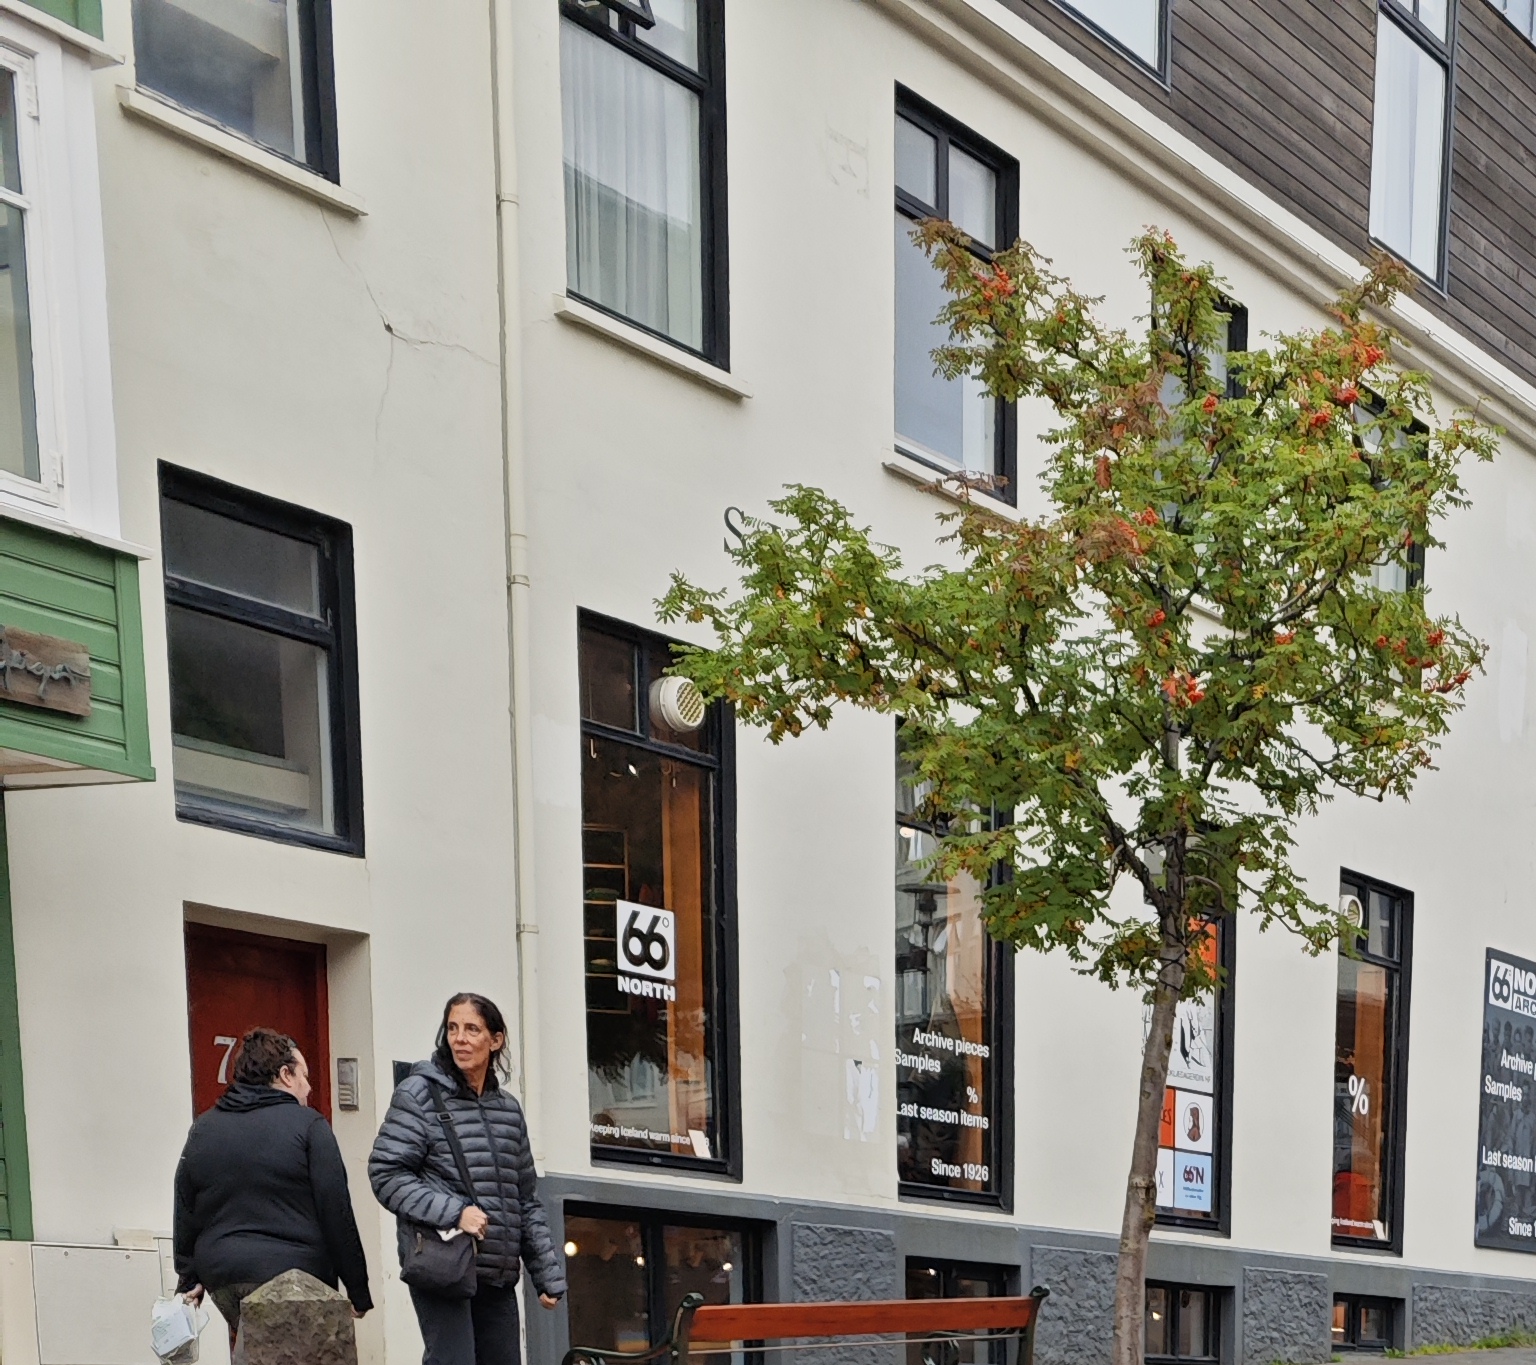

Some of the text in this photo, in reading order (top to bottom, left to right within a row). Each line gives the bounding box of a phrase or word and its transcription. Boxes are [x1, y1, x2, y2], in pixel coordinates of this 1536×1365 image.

[617, 975, 676, 1001] NORTH
[912, 1027, 990, 1058] Archive pieces
[895, 1048, 941, 1073] Samples
[1500, 1049, 1533, 1075] Archive
[966, 1086, 979, 1103] %
[1349, 1075, 1368, 1115] %
[1484, 1075, 1523, 1102] Samples
[919, 1107, 958, 1125] season
[960, 1109, 989, 1129] items
[931, 1158, 989, 1181] Since 1926
[1482, 1145, 1501, 1167] Last
[1502, 1153, 1533, 1173] season
[1509, 1217, 1532, 1238] Since
